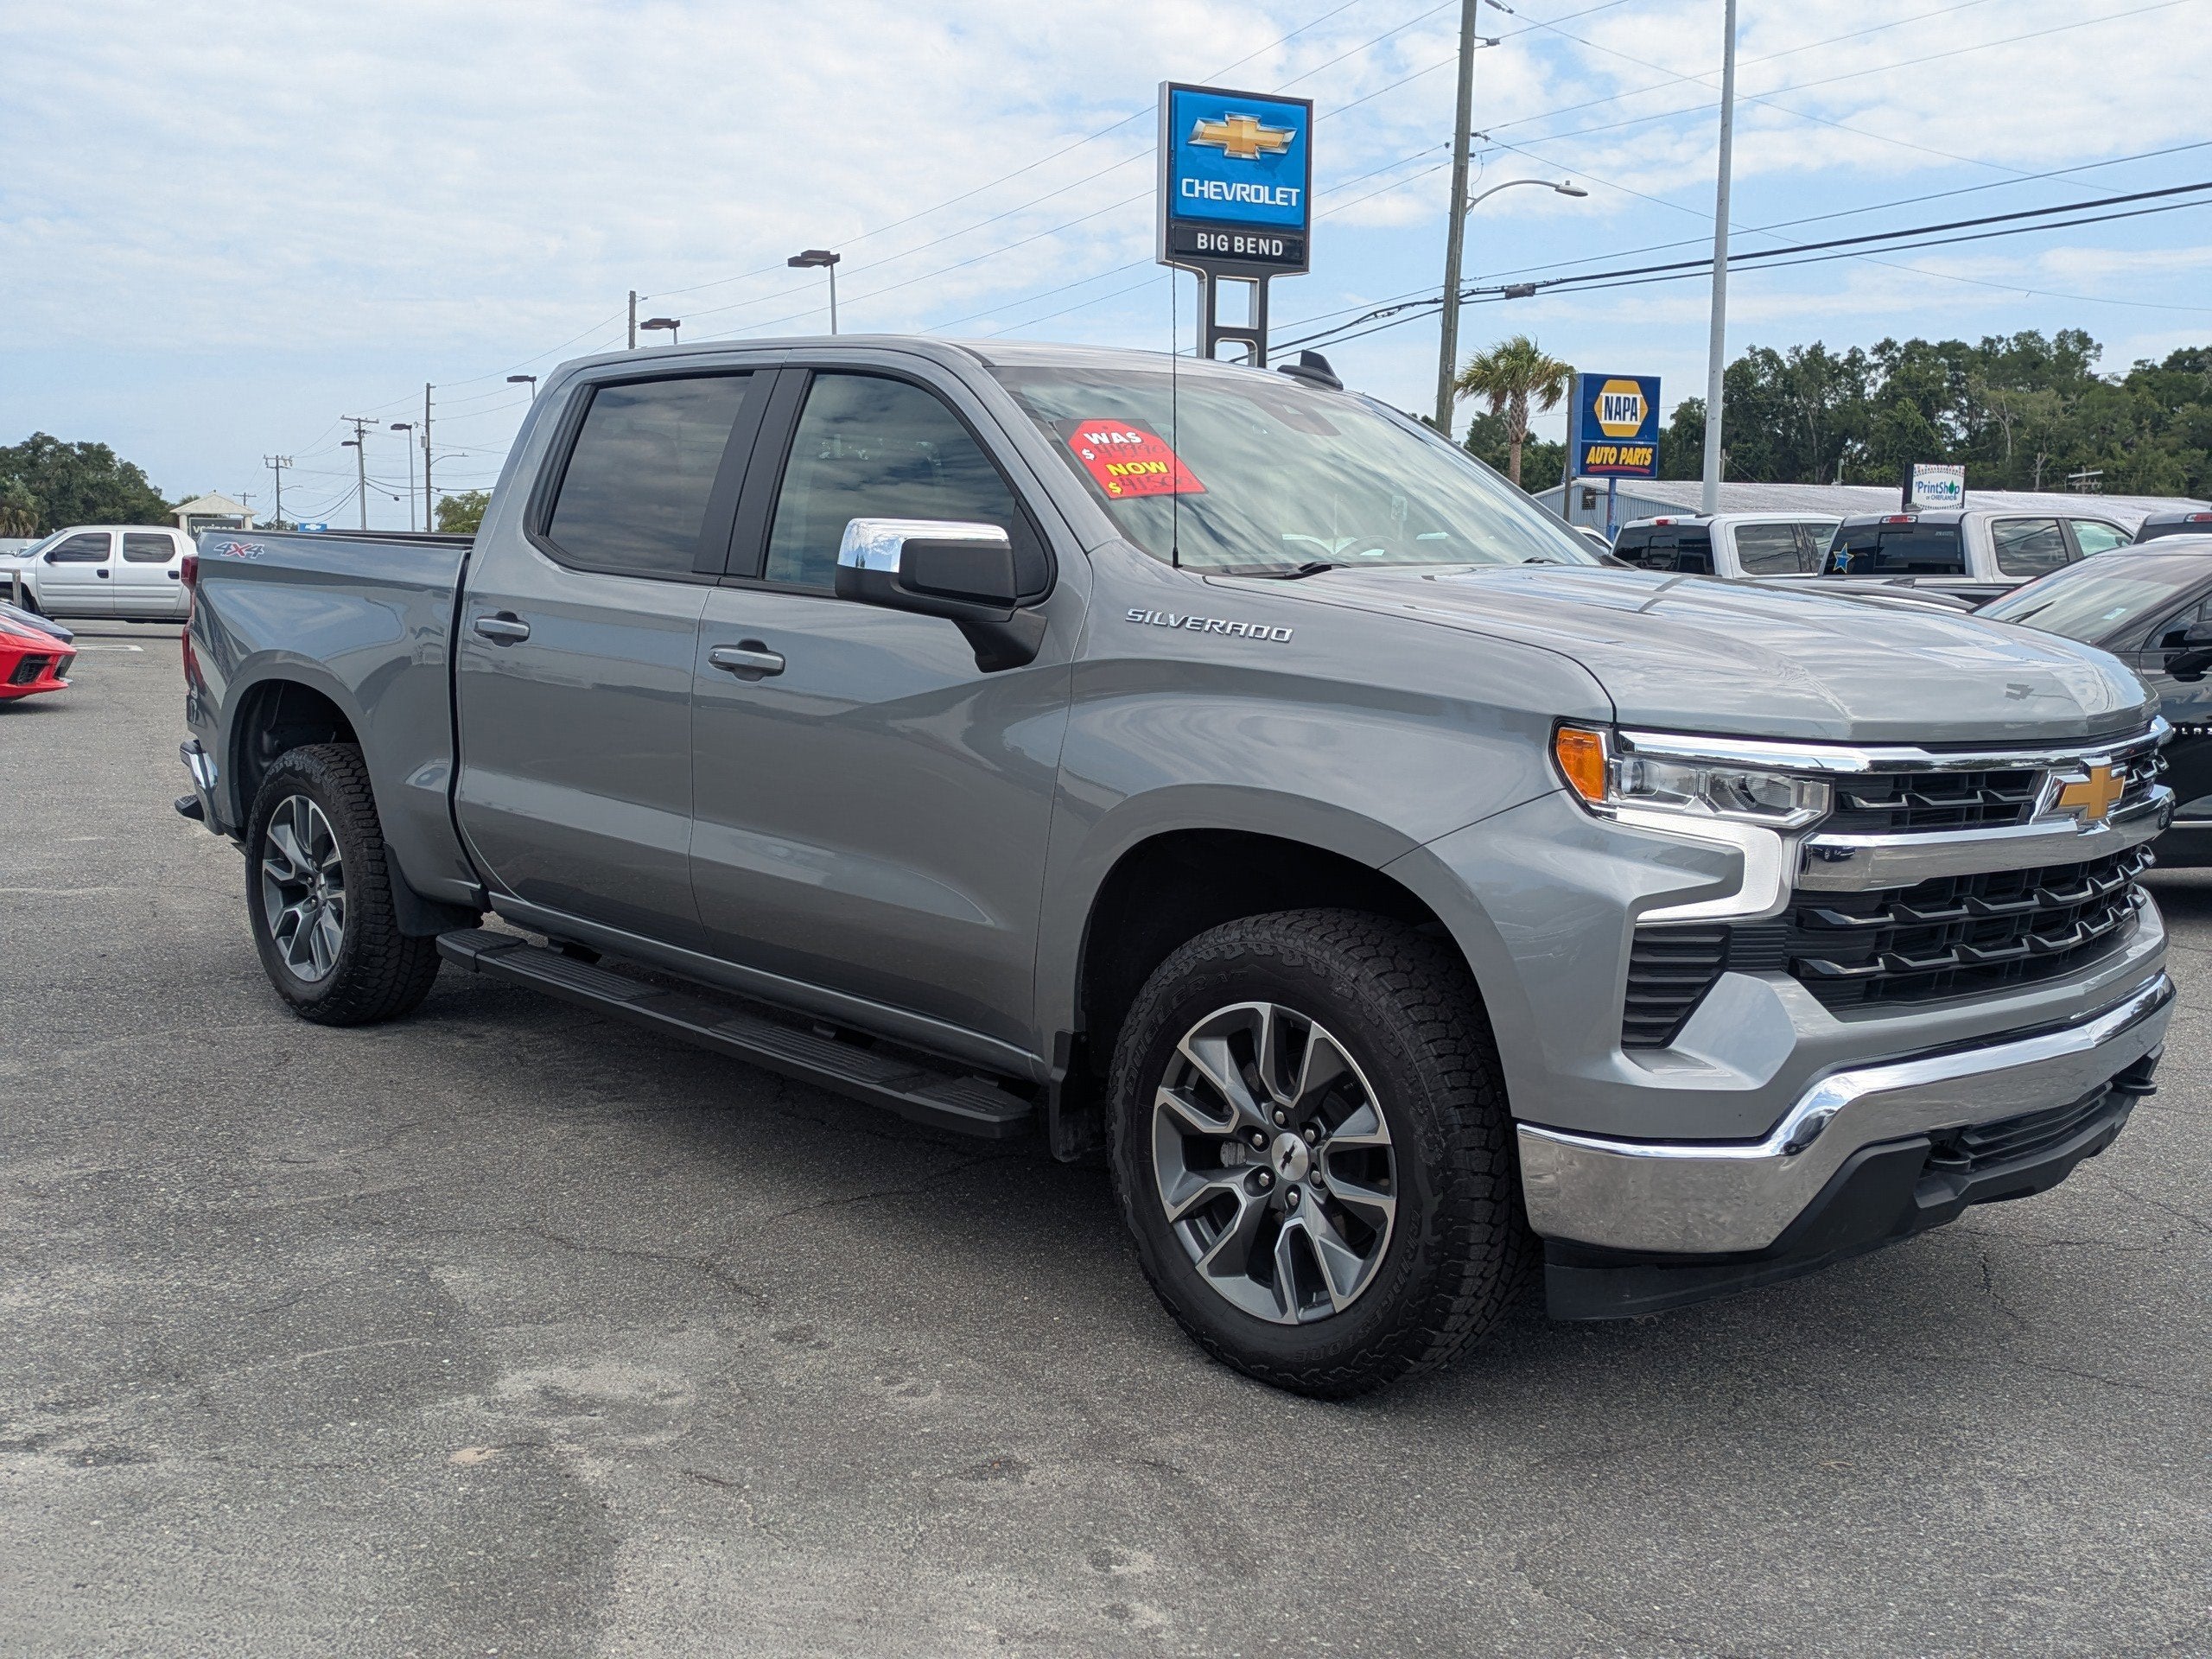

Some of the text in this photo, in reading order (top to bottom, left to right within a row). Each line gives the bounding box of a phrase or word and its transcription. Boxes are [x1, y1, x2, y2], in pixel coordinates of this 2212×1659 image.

[1181, 178, 1300, 207] CHEVROLET
[1197, 232, 1283, 257] BIG BEND
[1605, 395, 1638, 422] NAPA
[1084, 431, 1143, 445] WAS
[1106, 461, 1169, 476] NOW
[1586, 446, 1653, 466] AUTO PARTS
[1125, 607, 1294, 643] SILVERADO
